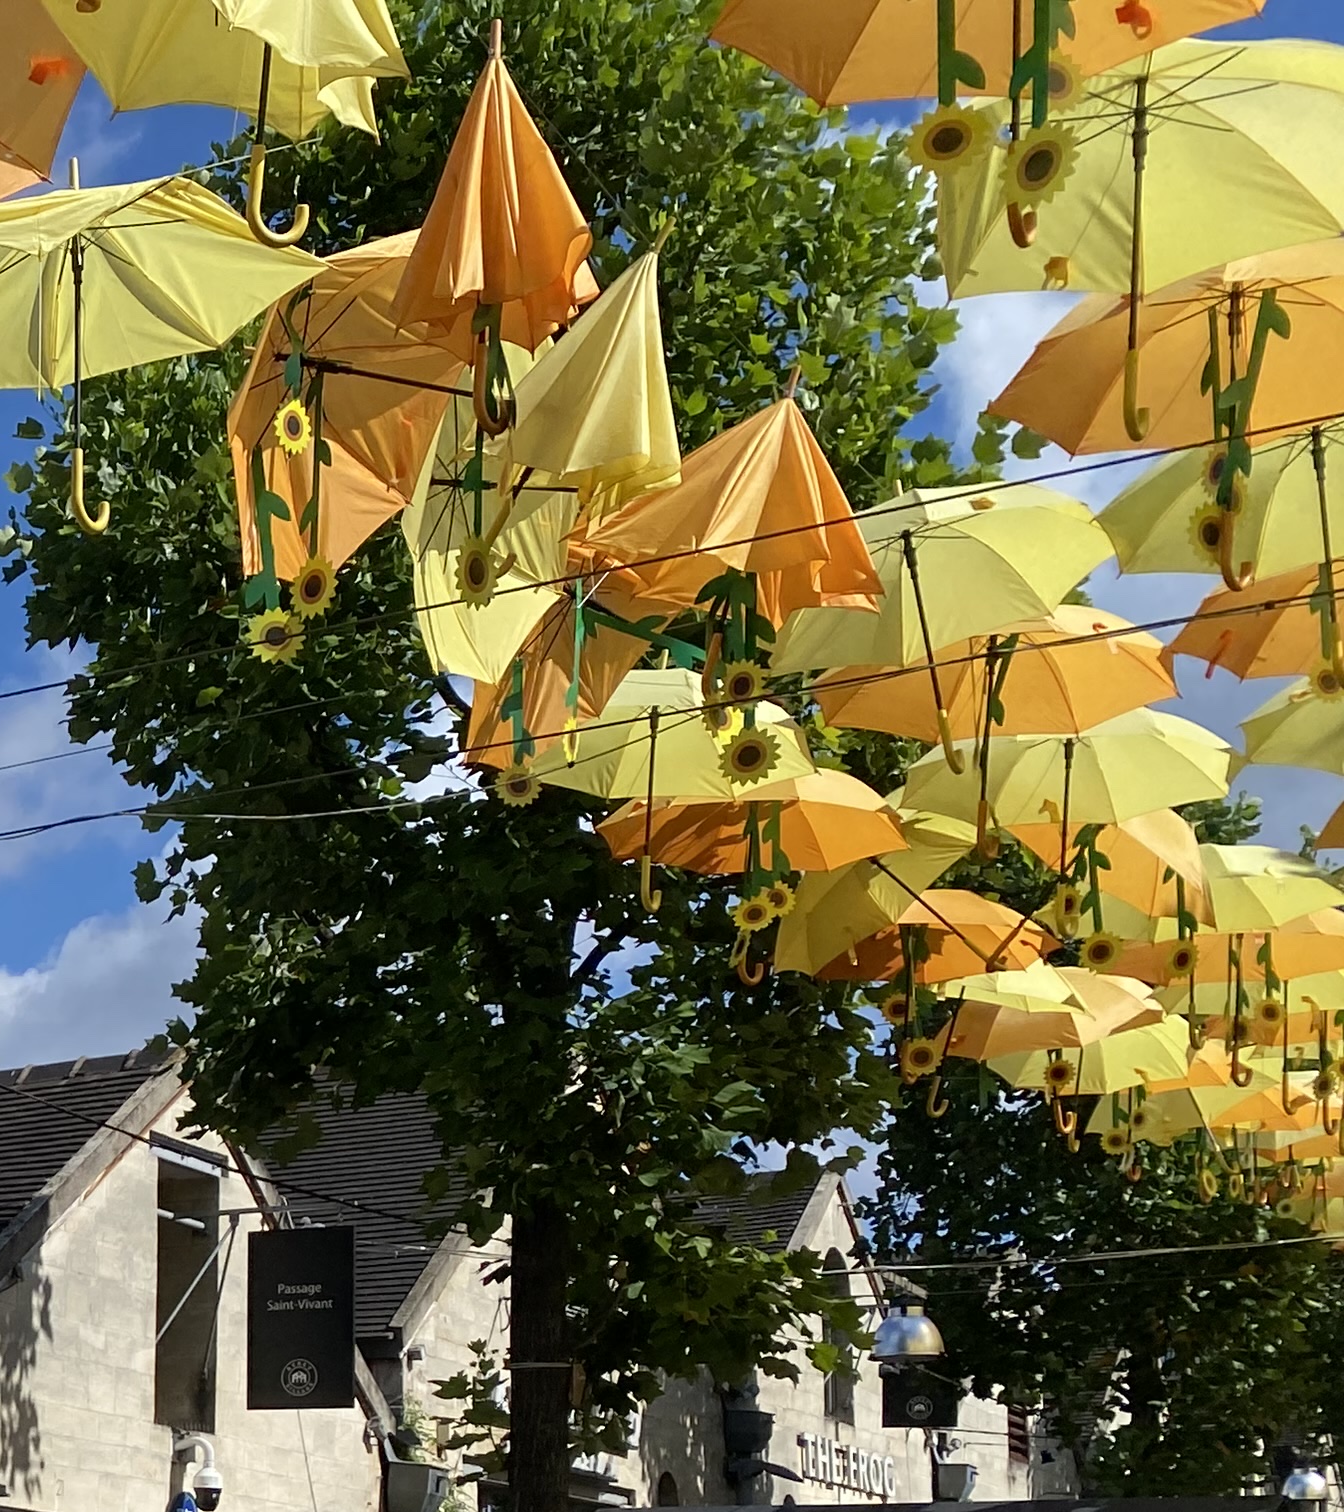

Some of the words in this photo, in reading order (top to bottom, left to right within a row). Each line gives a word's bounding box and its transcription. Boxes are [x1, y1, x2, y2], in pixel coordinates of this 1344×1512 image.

[277, 1283, 322, 1296] Passage
[267, 1299, 333, 1312] Saint-Vivant
[797, 1431, 841, 1485] THE
